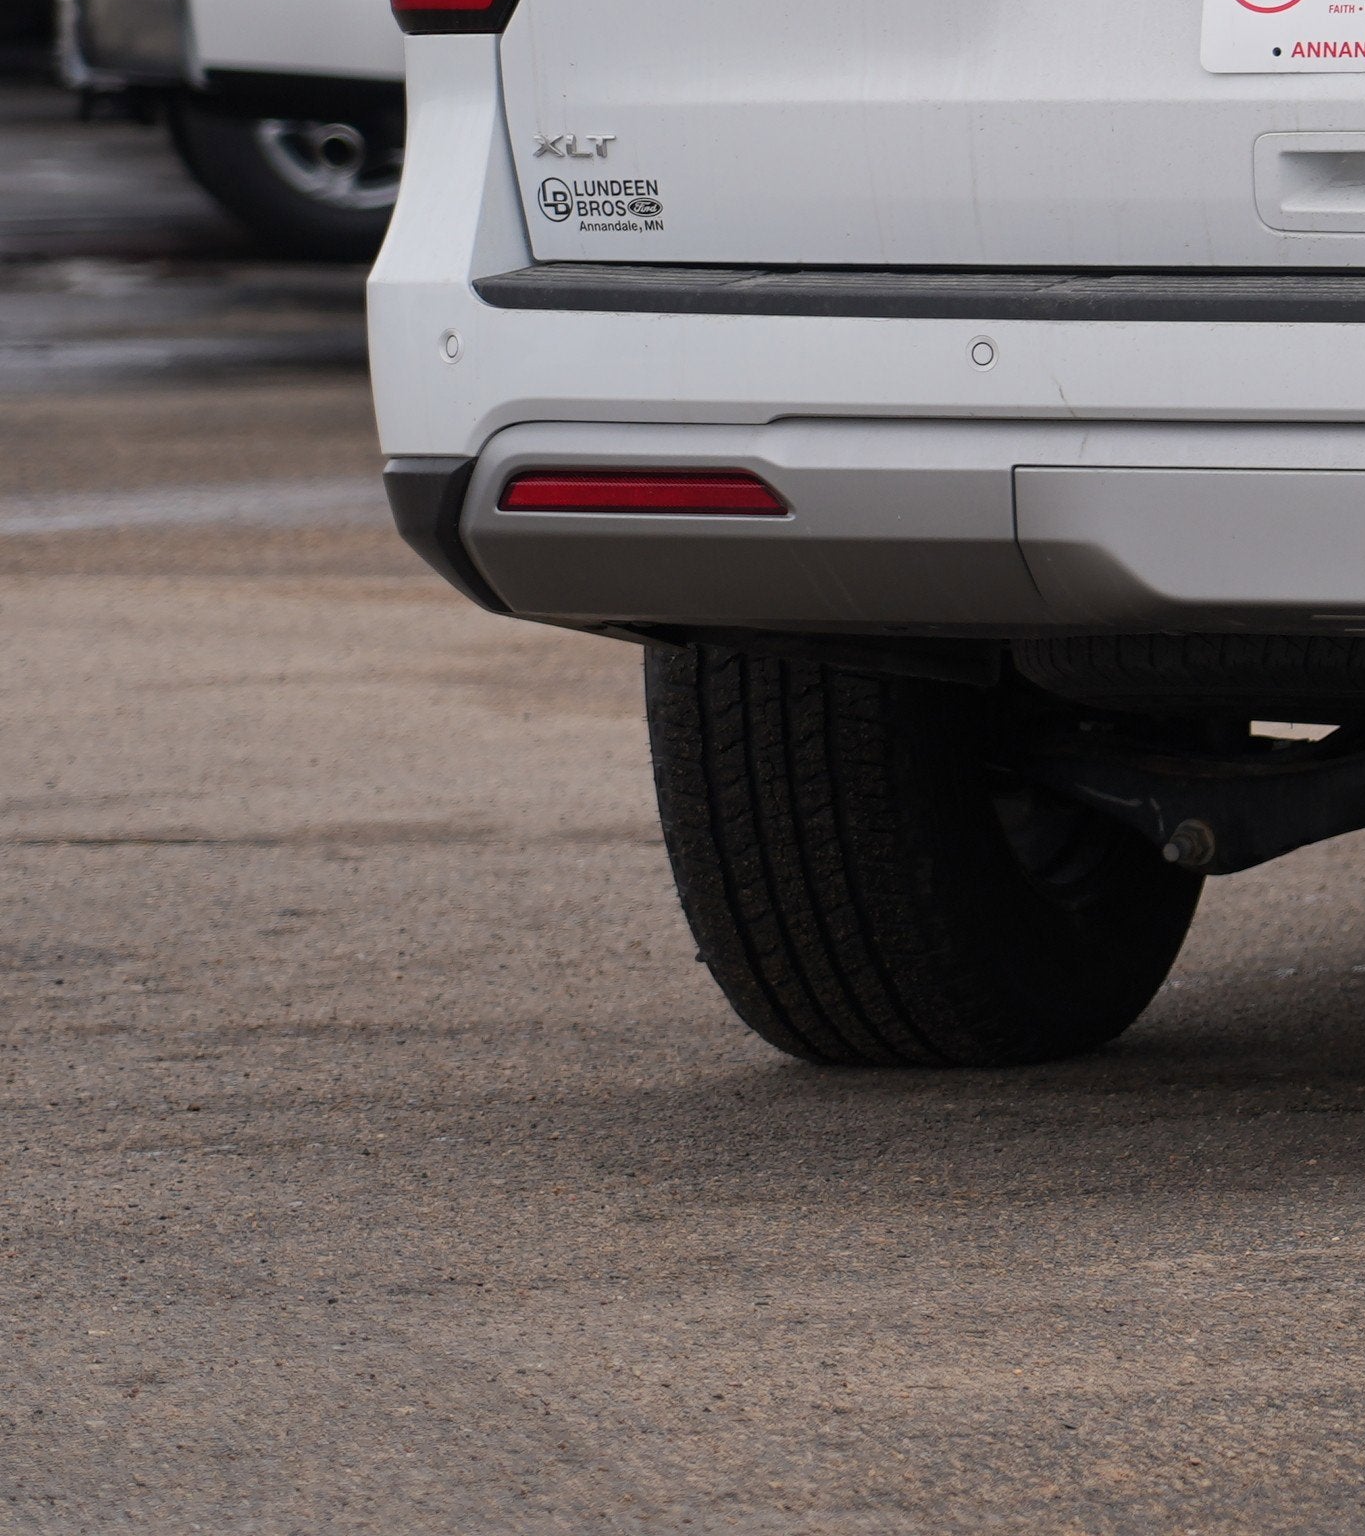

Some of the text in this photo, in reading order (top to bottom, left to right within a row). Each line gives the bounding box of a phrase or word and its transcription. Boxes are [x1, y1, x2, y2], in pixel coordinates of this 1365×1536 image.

[1328, 4, 1356, 14] FAITH
[533, 134, 617, 158] XLT
[573, 180, 659, 197] LUNDEEN
[577, 200, 658, 217] BROS Ford
[579, 220, 664, 233] Annandale, MN
